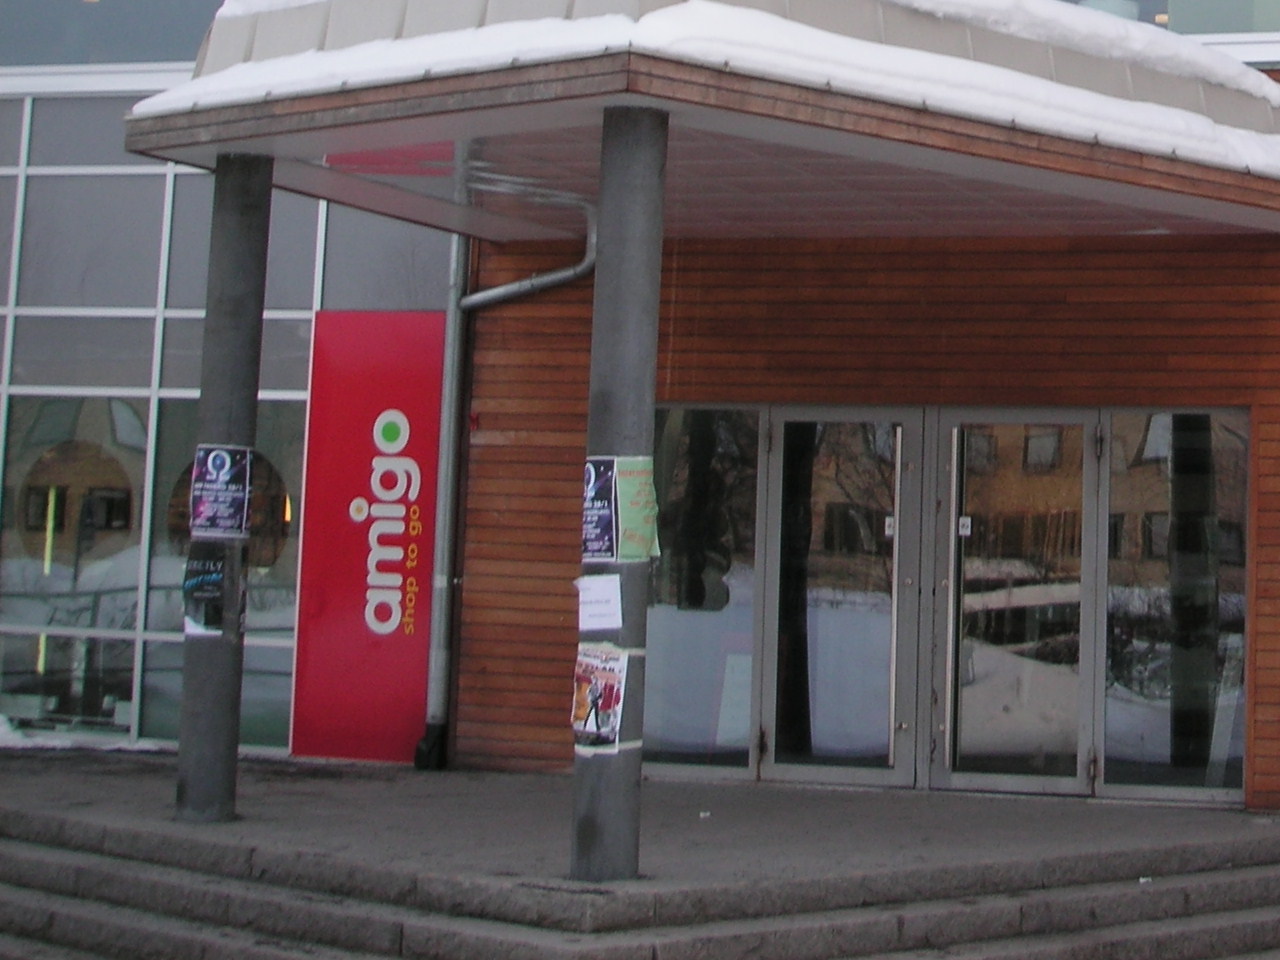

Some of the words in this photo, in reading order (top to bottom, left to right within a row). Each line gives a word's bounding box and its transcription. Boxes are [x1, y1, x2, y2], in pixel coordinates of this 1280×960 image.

[349, 409, 421, 635] amigo
[408, 504, 422, 536] go
[406, 543, 418, 569] to
[402, 576, 419, 635] shop
